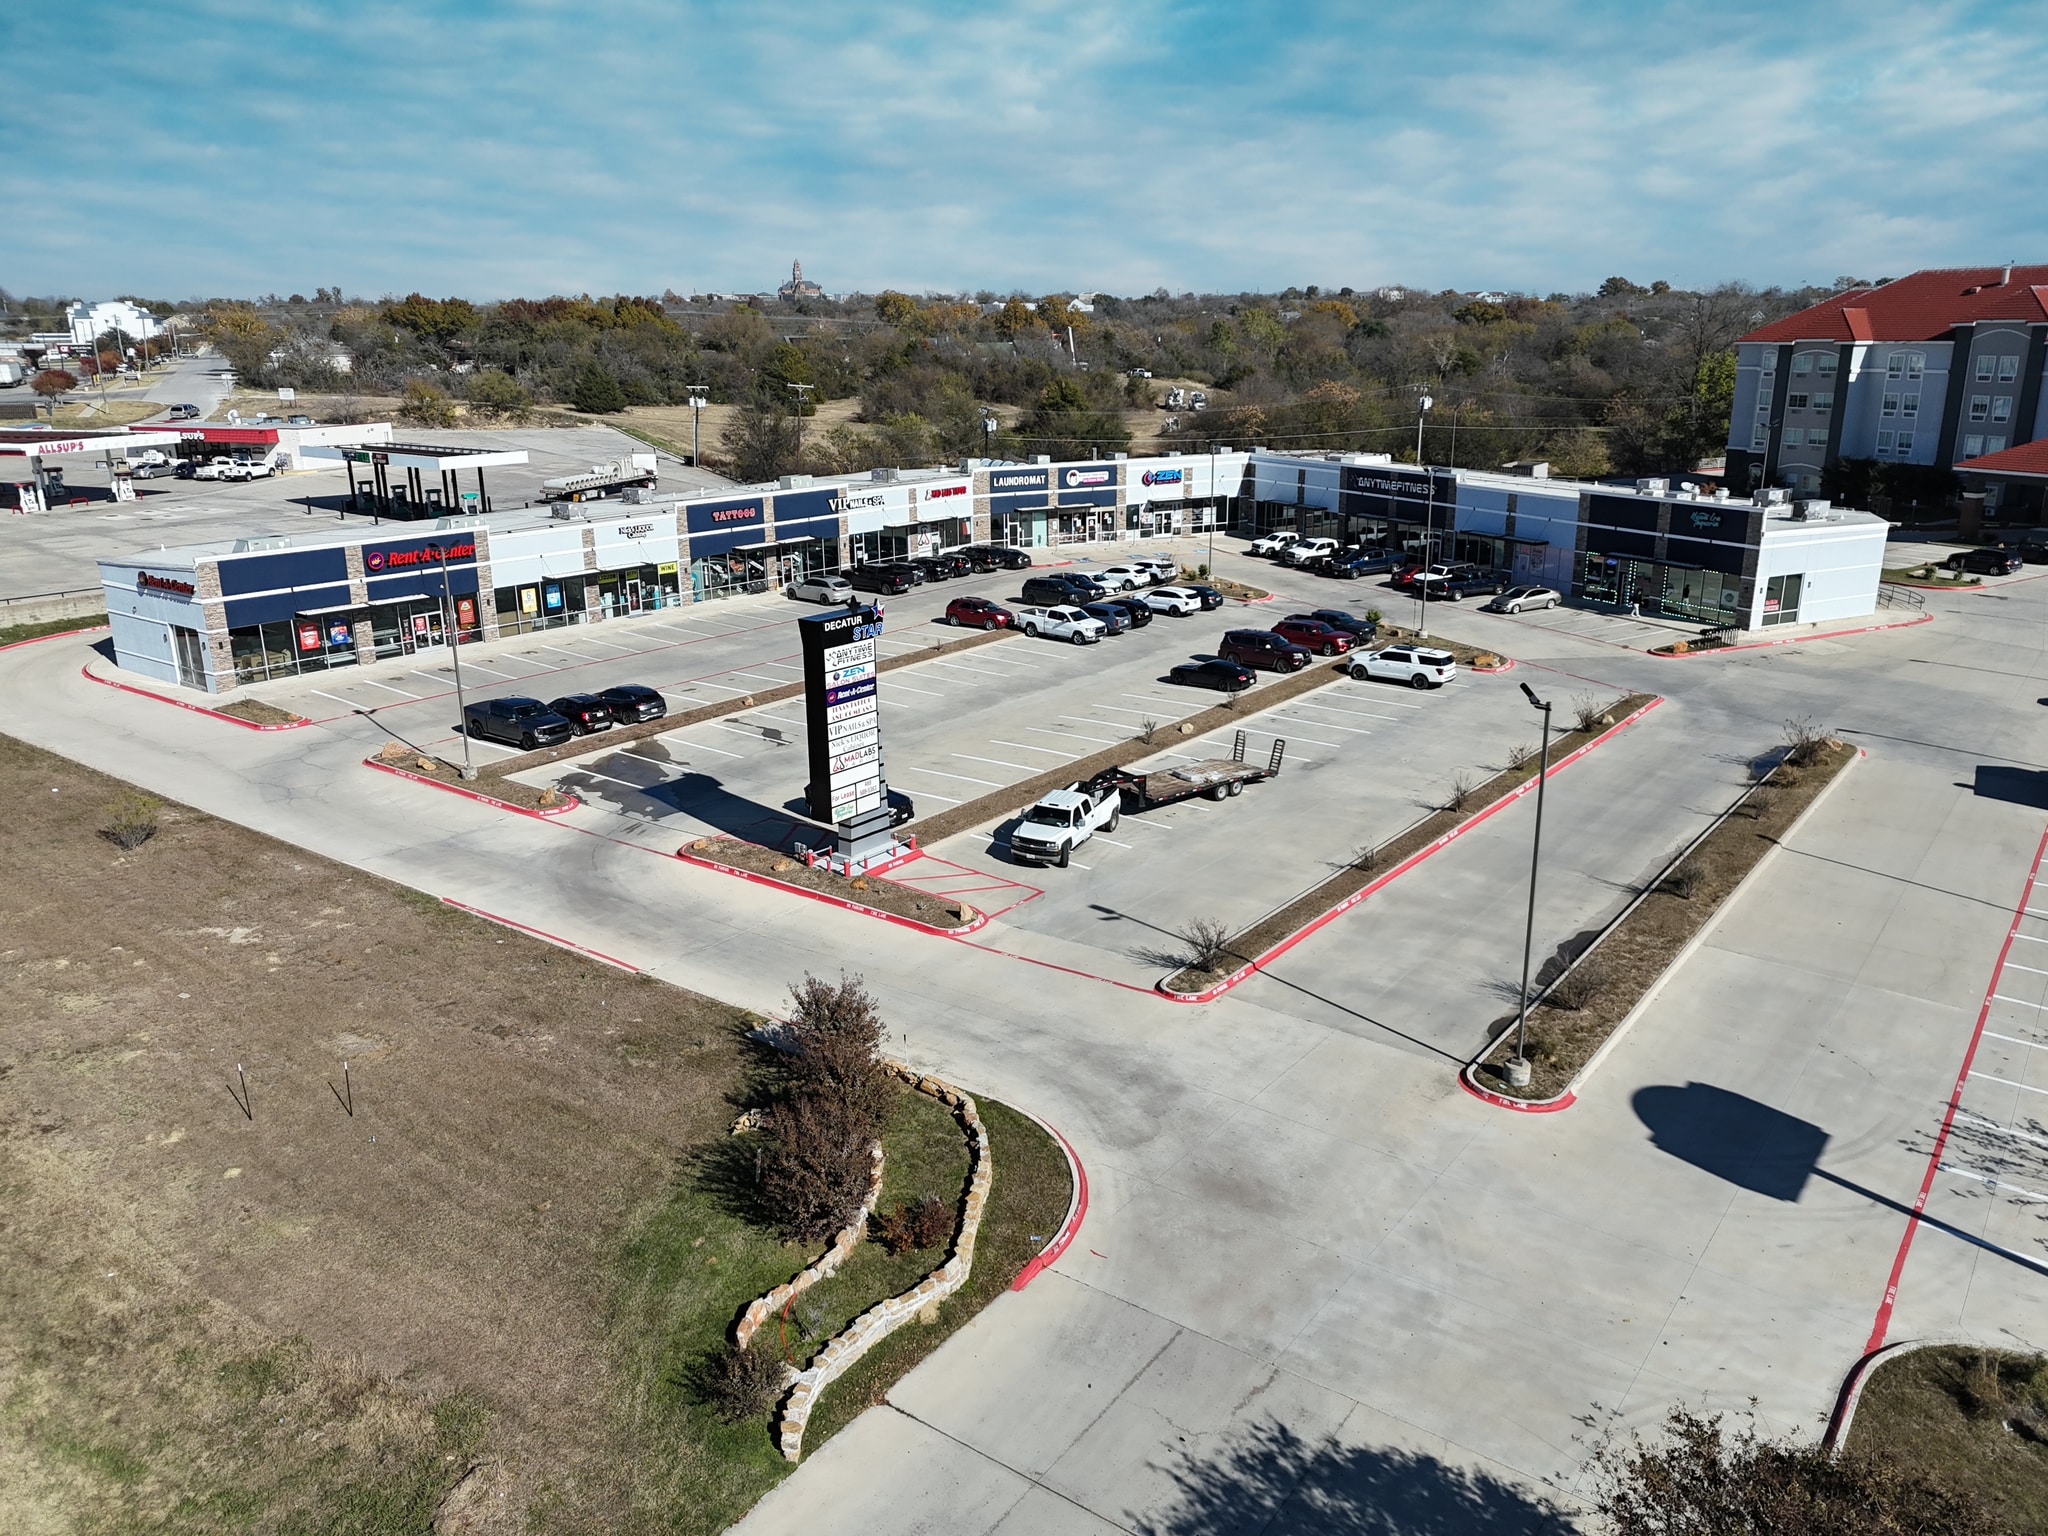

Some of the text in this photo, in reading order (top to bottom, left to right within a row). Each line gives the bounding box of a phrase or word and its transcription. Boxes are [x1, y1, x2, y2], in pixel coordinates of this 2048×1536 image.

[38, 441, 84, 455] ALLSUP'S
[994, 475, 1046, 487] LAUNDROMAT
[1156, 469, 1182, 481] ZEN
[828, 497, 849, 512] VIP
[849, 497, 867, 509] NAILS
[712, 507, 756, 522] TATTOOS
[660, 564, 675, 572] WINE
[824, 615, 863, 632] DECATUR
[853, 622, 883, 641] STAR
[836, 642, 873, 659] ANYTIME
[837, 651, 873, 666] FITNESS
[842, 666, 866, 678] ZEN
[829, 724, 843, 736] VIP
[843, 721, 862, 731] NAILS
[841, 790, 855, 800] Lease
